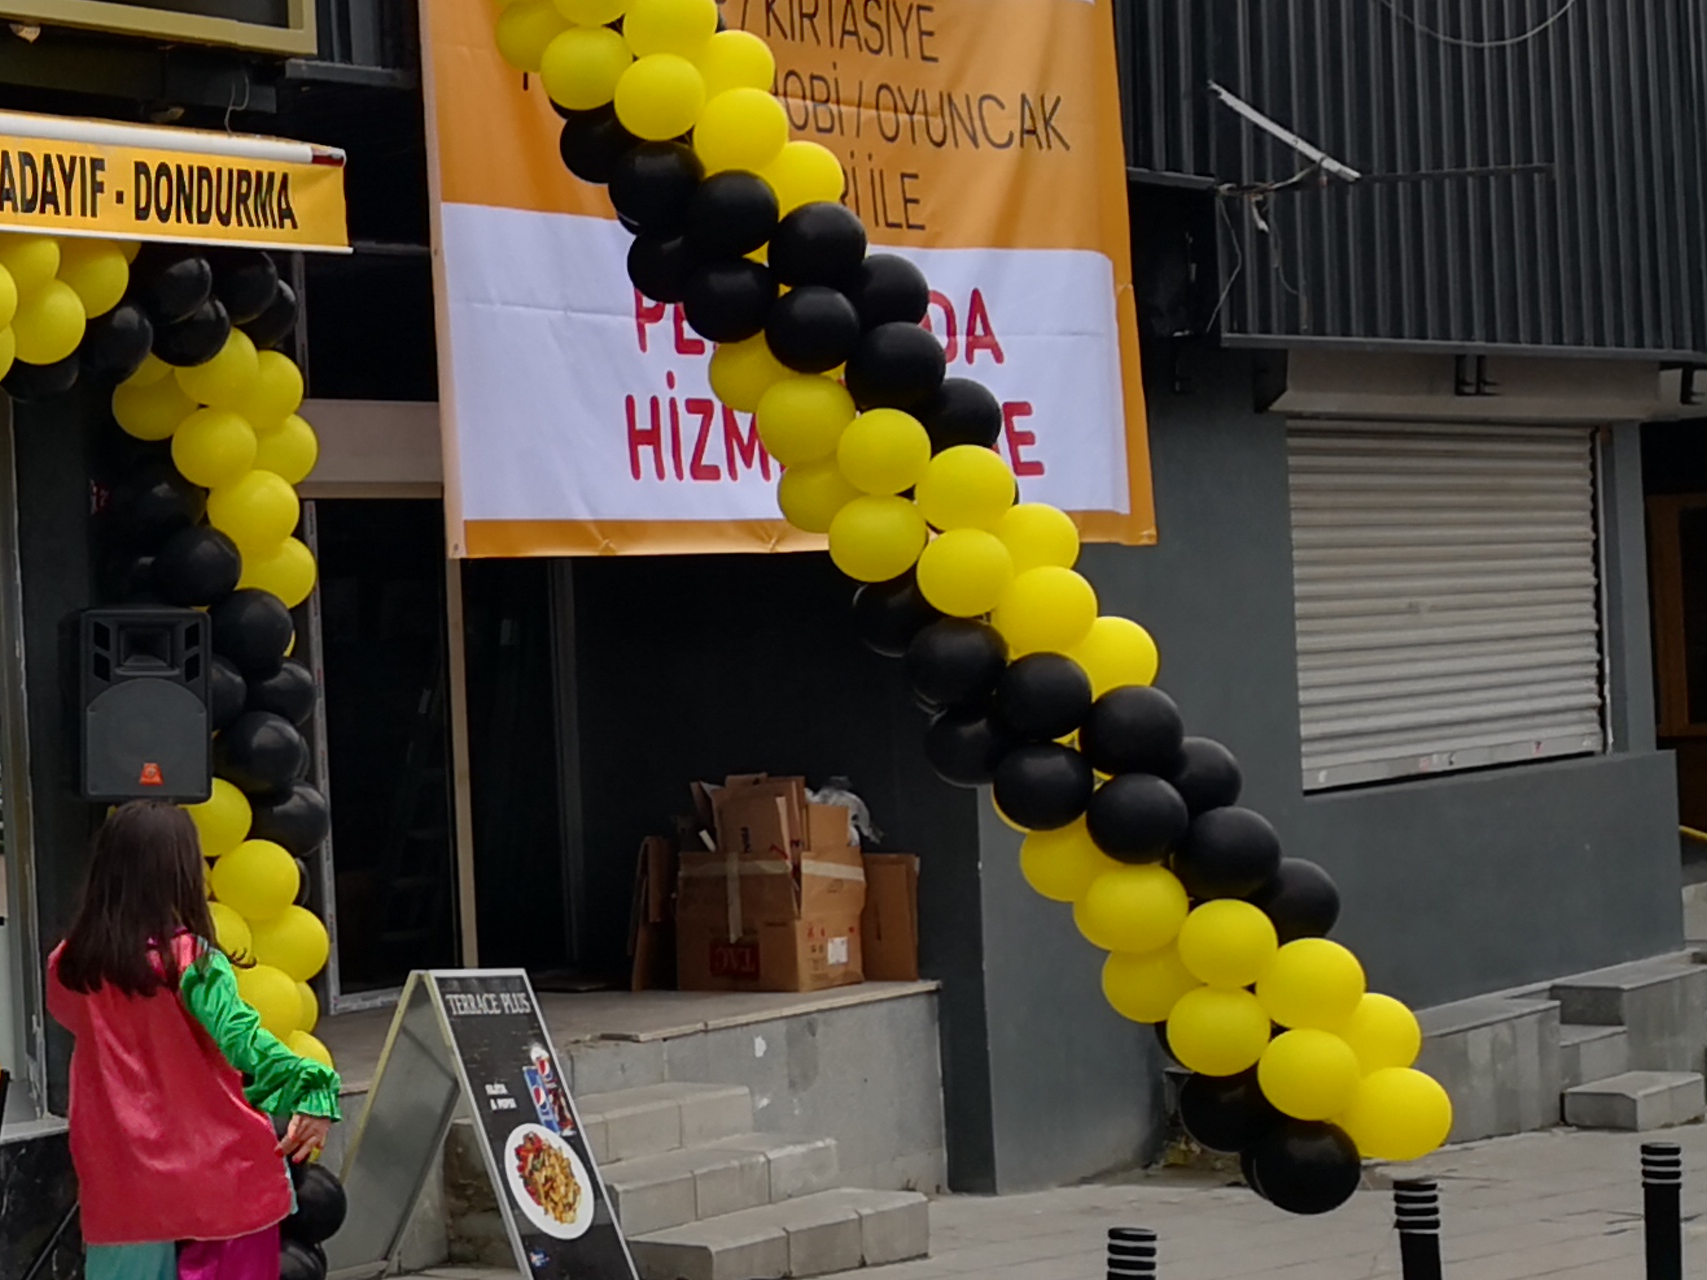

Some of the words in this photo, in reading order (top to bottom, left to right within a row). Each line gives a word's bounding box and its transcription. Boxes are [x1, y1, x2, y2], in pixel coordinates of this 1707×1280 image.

[773, 61, 845, 137] OBİ
[875, 83, 1071, 151] OYUNCAK
[133, 160, 299, 231] DONDURMA
[868, 151, 926, 230] İLE
[445, 993, 501, 1016] TERRACE
[499, 992, 532, 1015] PLUS
